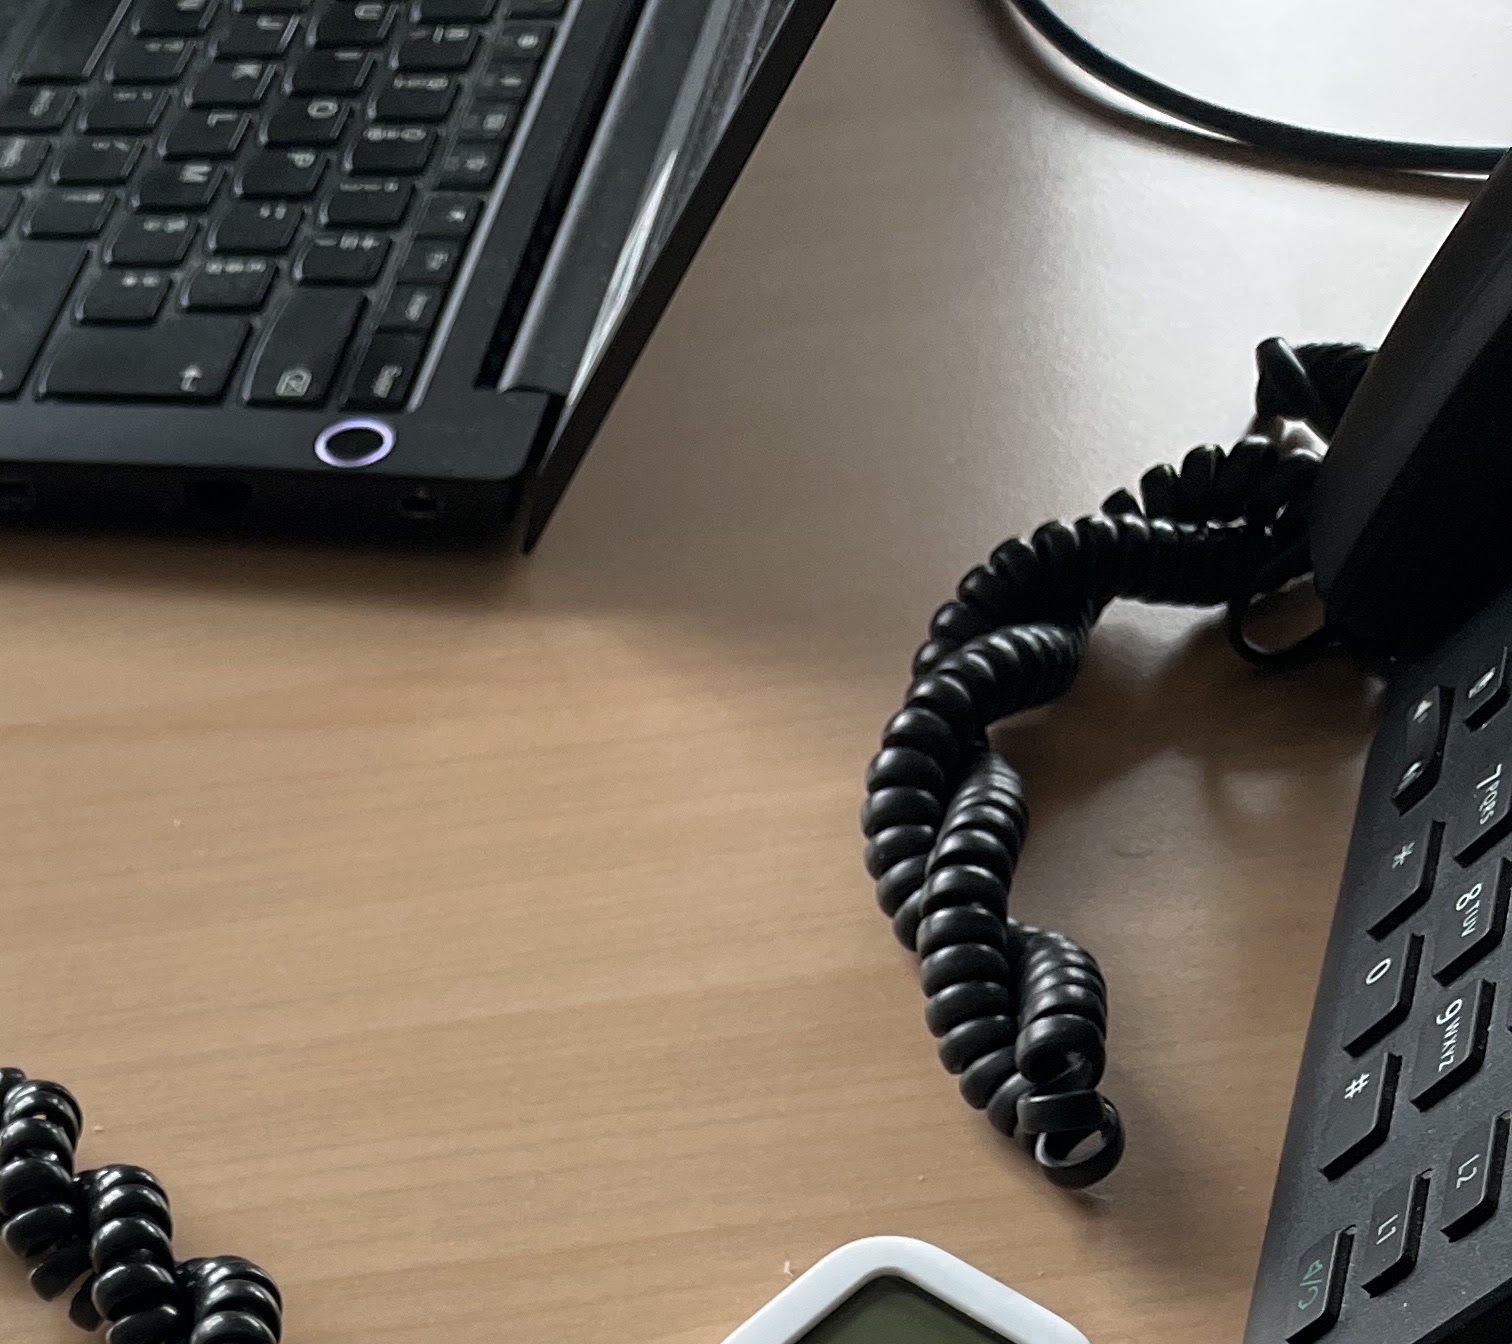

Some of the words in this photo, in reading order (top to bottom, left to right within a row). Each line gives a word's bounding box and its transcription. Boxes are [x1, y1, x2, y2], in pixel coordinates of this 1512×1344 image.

[1456, 883, 1483, 911] 8
[1365, 958, 1392, 985] 0
[1436, 998, 1463, 1025] 9
[1456, 1153, 1480, 1189] L2
[1376, 1214, 1399, 1245] L1
